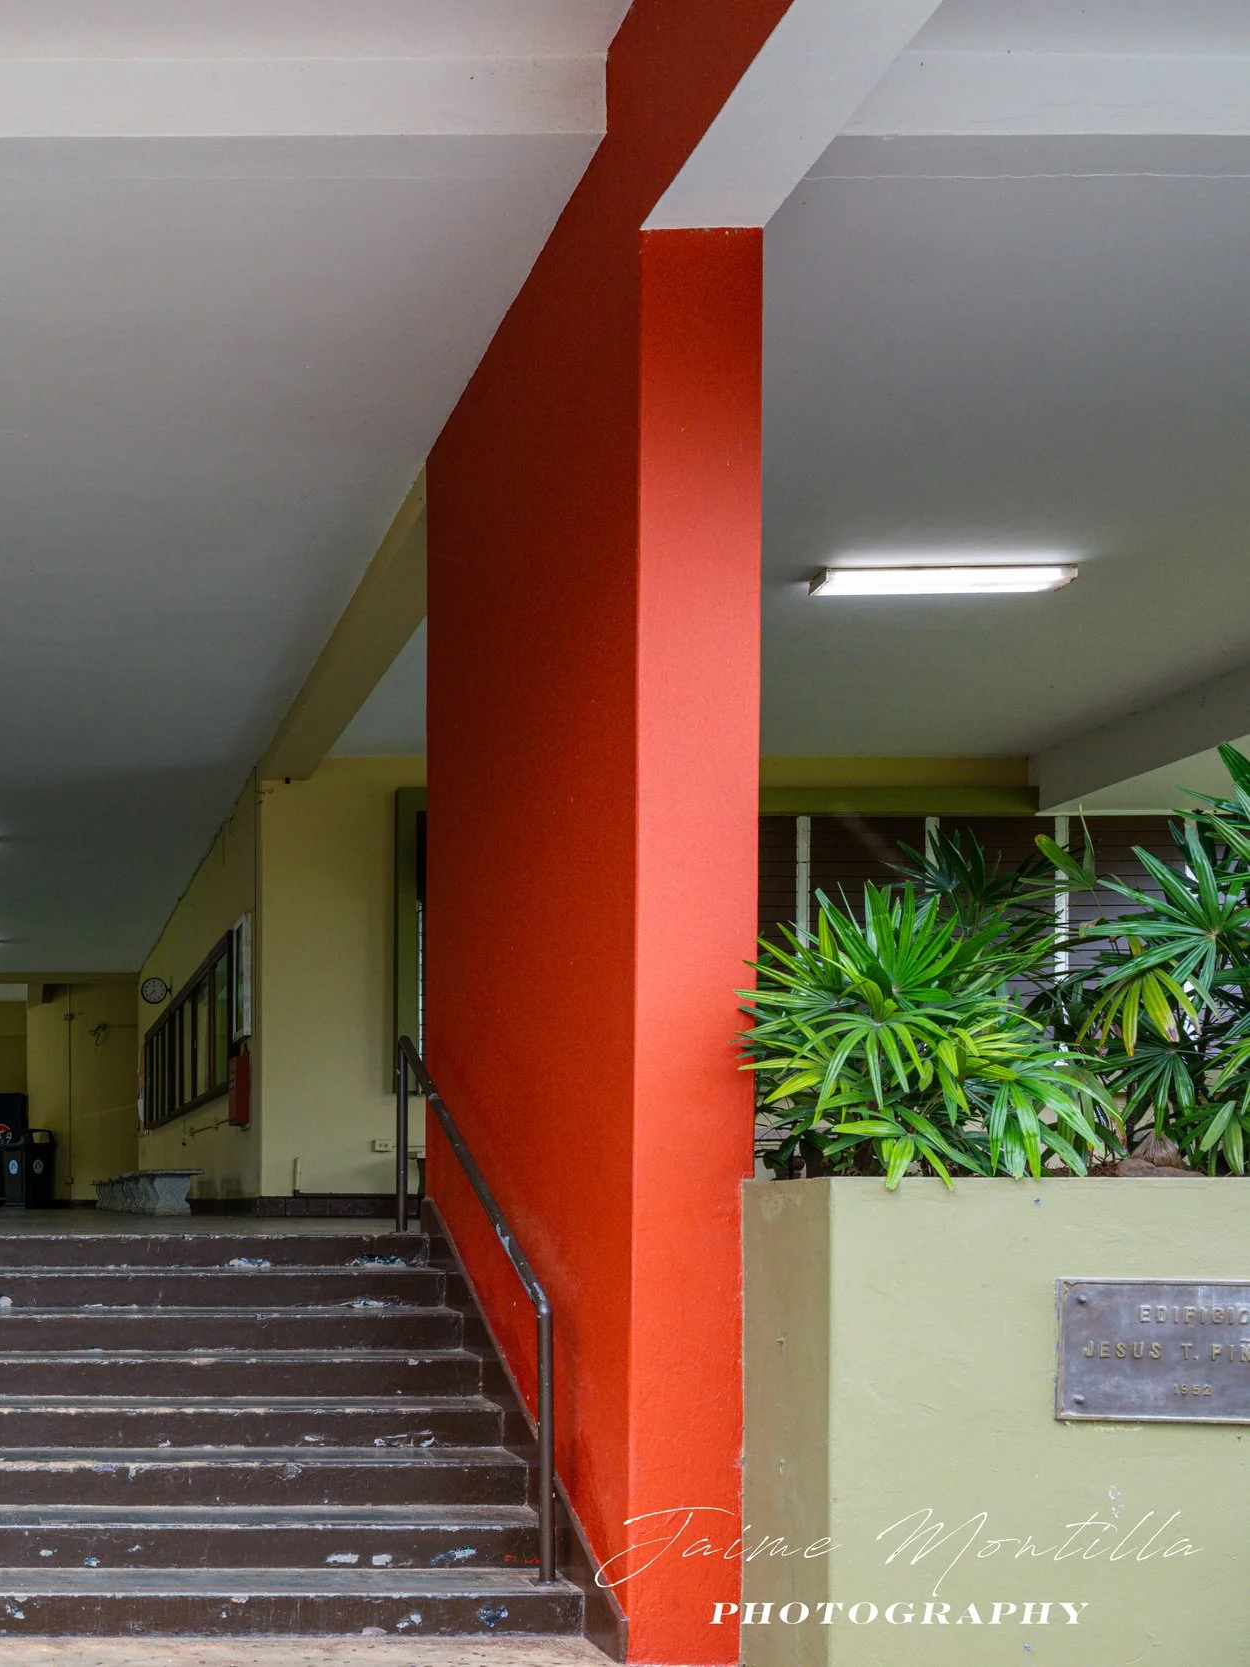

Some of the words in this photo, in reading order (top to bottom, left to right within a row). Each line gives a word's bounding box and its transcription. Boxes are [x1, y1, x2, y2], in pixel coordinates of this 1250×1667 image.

[1139, 1304, 1250, 1325] EDIFICIO
[1082, 1341, 1163, 1360] JESUS
[1181, 1343, 1200, 1361] T.
[1173, 1384, 1213, 1397] 1952
